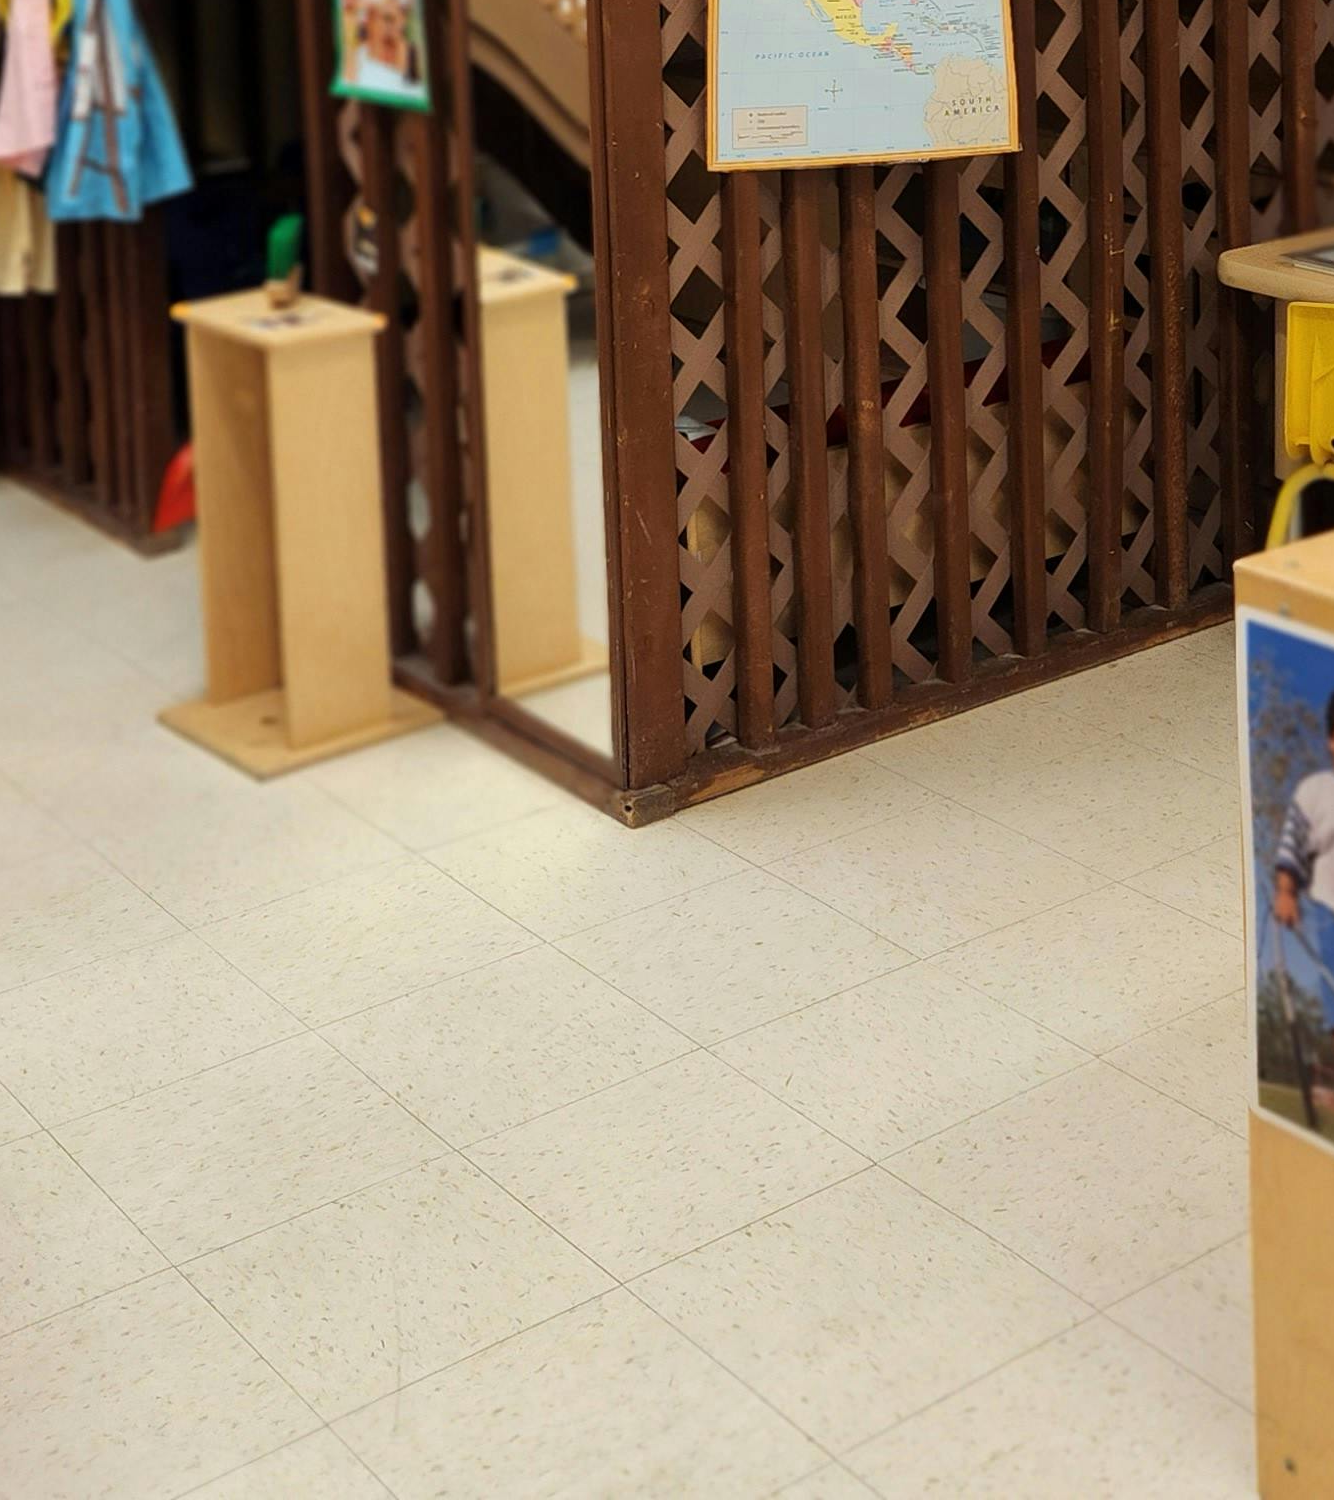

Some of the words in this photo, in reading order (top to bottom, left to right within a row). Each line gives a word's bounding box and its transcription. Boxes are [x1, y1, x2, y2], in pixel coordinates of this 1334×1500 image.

[755, 52, 794, 60] PACIFIC
[951, 97, 992, 107] SOUTH
[944, 106, 1000, 116] AMERICA
